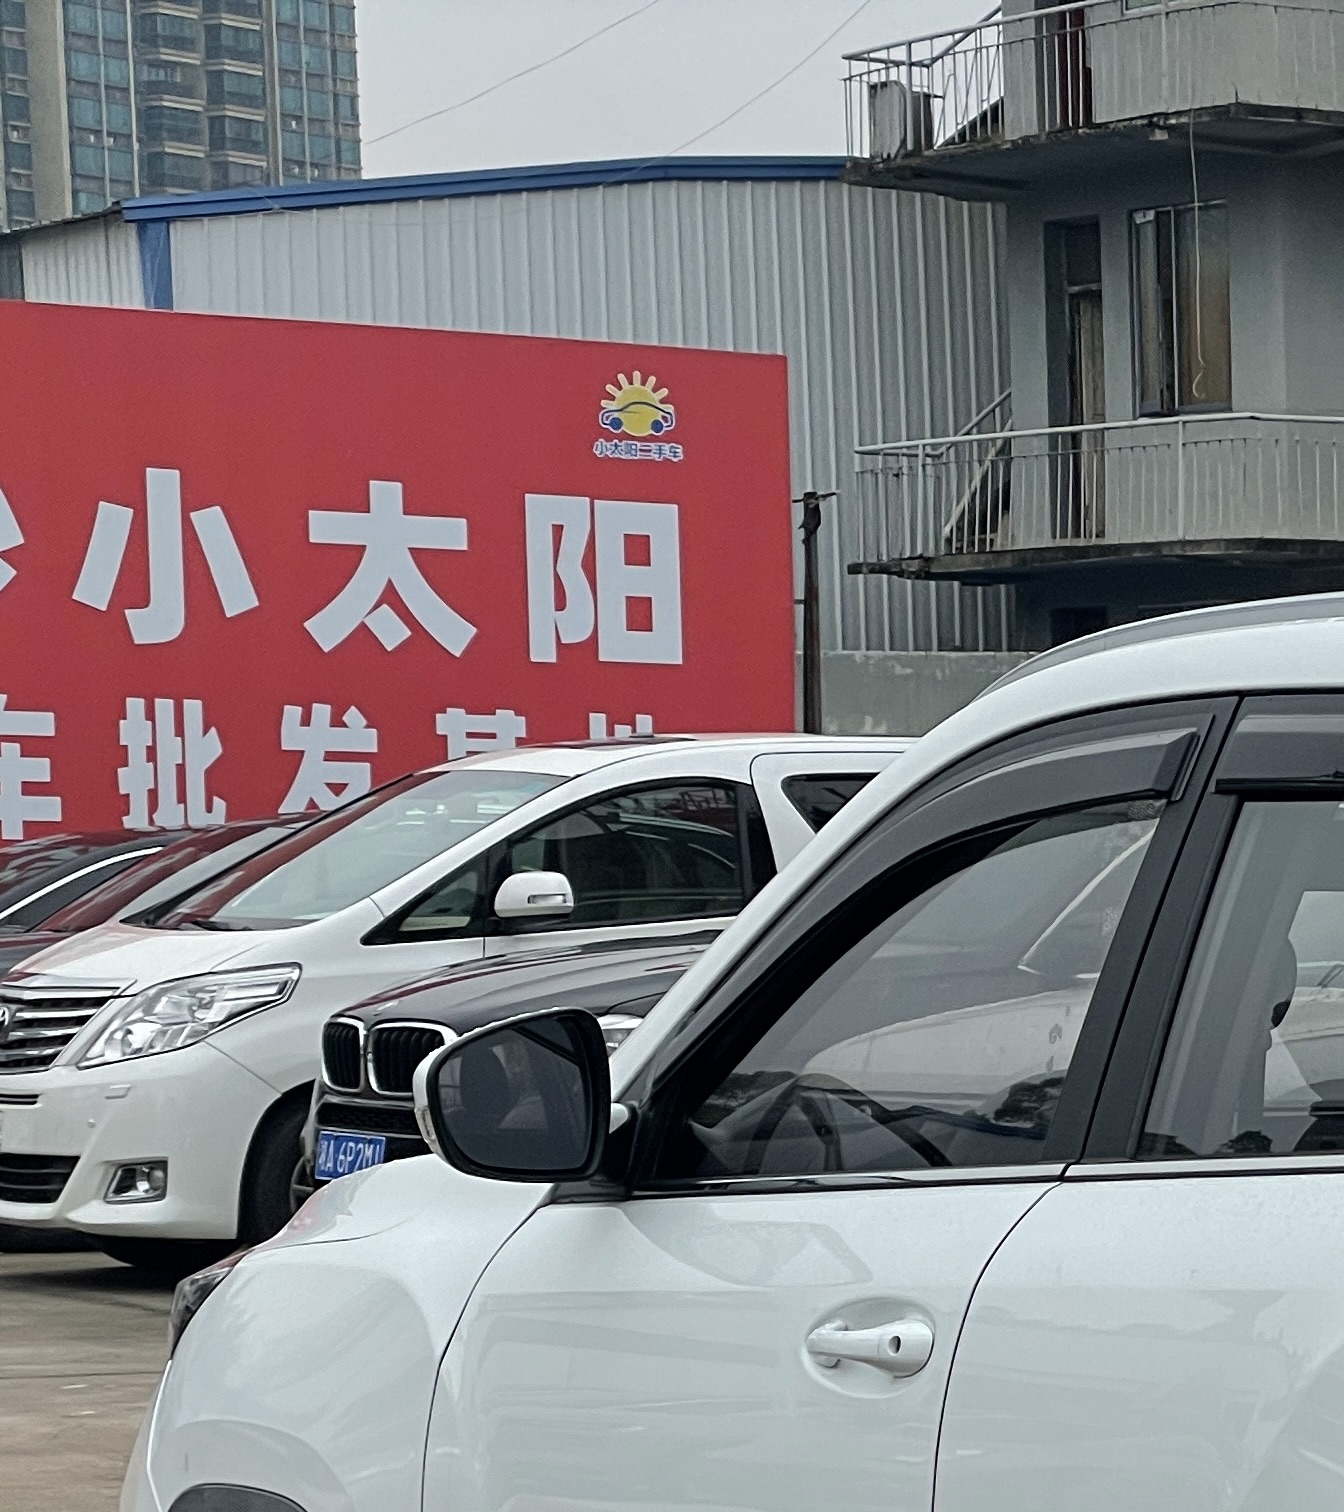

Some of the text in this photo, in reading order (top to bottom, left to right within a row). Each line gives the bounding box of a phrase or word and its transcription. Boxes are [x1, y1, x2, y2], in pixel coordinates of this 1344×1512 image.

[593, 439, 683, 461] 小太阳二手车
[0, 467, 683, 664] 小太阳
[0, 693, 653, 840] 车批发
